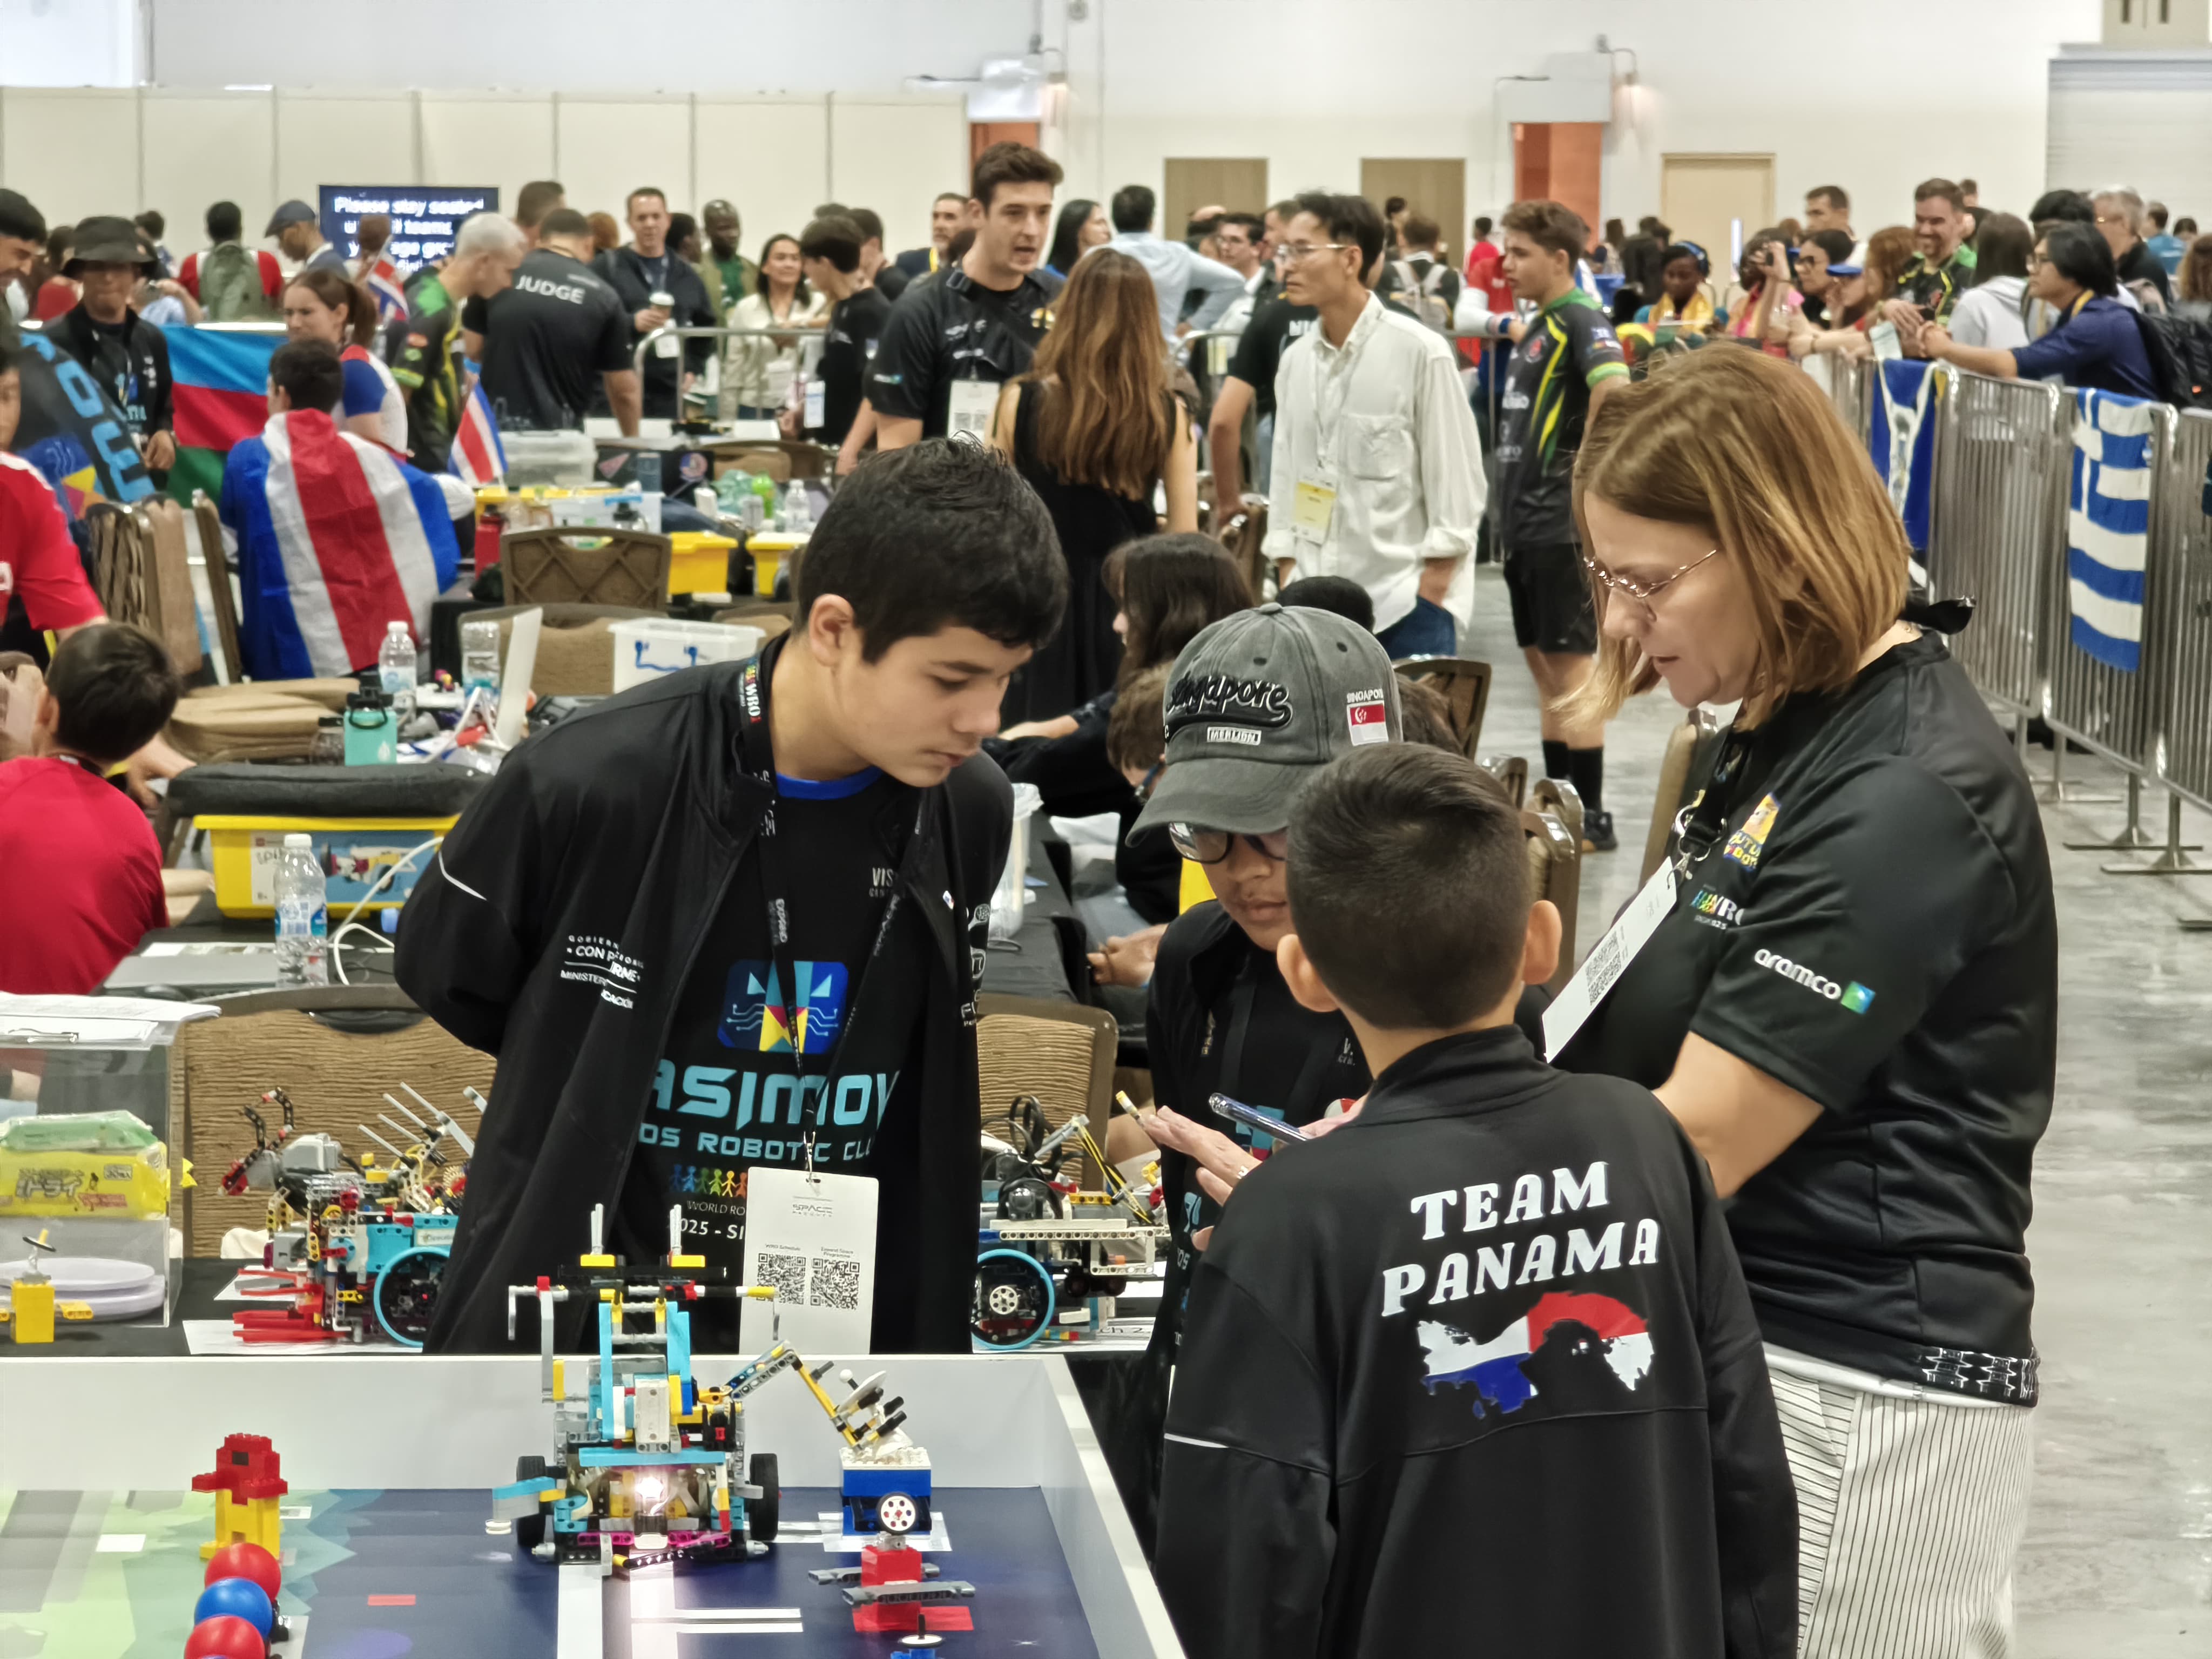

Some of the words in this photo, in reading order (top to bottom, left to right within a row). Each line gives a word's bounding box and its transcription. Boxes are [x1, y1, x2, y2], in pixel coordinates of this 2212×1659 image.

[392, 199, 427, 217] stay
[515, 274, 585, 305] JUDGE
[575, 945, 605, 959] CON
[1754, 948, 1842, 1000] aramco
[687, 1200, 728, 1214] WORLD
[730, 1205, 746, 1216] RO
[1410, 1161, 1610, 1240] TEAM
[680, 1218, 709, 1236] 025
[726, 1224, 745, 1240] SI
[1381, 1218, 1659, 1317] PANAMA
